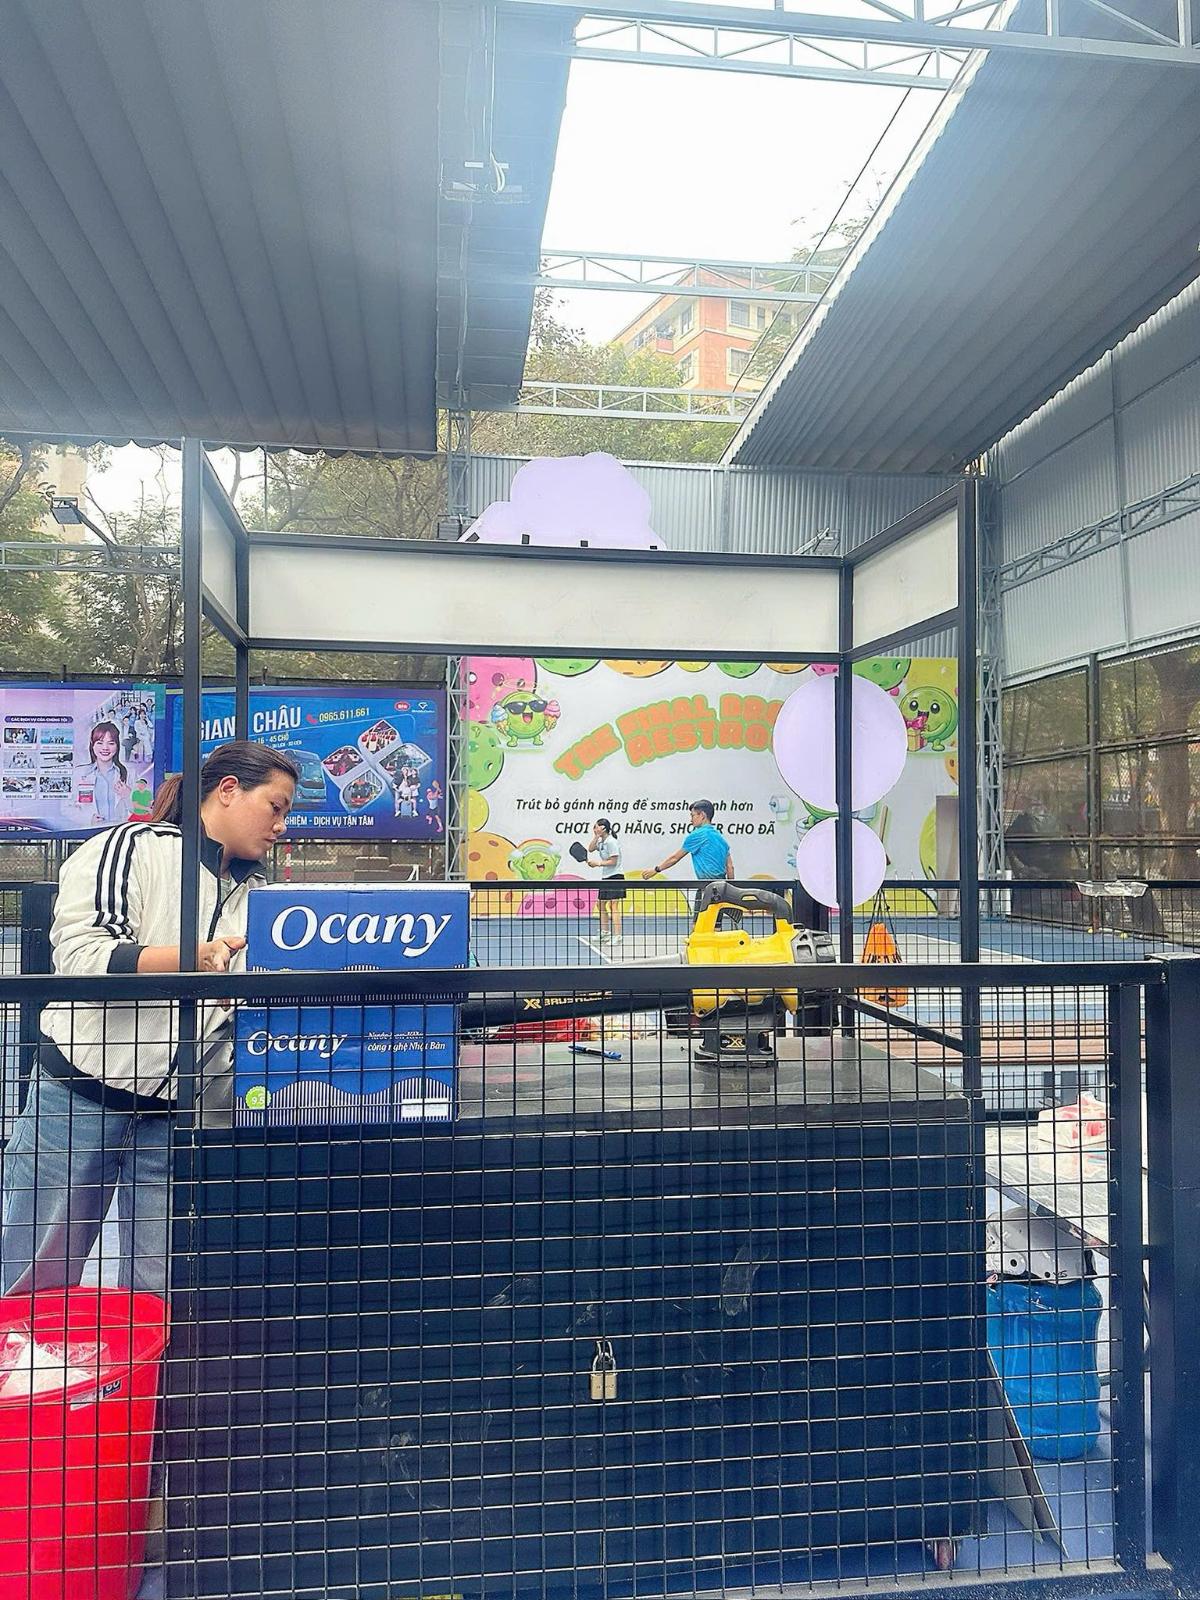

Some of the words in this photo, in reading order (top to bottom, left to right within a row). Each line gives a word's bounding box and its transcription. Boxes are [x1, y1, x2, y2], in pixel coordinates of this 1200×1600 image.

[200, 716, 236, 741] IAN
[253, 705, 301, 733] CHÂU
[319, 707, 370, 722] 0965.611.661
[553, 723, 622, 781] THE
[616, 694, 717, 737] FINAL
[624, 719, 774, 767] RESTRO
[516, 799, 541, 810] Trút
[544, 797, 560, 810] bỏ
[563, 799, 594, 812] gánh
[598, 799, 629, 813] nặng
[632, 797, 649, 810] để
[650, 800, 690, 811] smash
[730, 800, 753, 811] hơn
[284, 816, 308, 826] GHIỆM
[313, 816, 330, 827] DỊCH
[332, 816, 342, 827] VỤ
[343, 814, 357, 827] TẬN
[358, 814, 374, 826] TÂM
[555, 822, 590, 834] CHƠI
[624, 820, 665, 835] HĂNG,
[669, 822, 724, 835] SHOR
[727, 823, 755, 835] CHO
[757, 821, 775, 835] ĐÃ
[271, 905, 452, 957] Ocany
[247, 1030, 347, 1058] Ocany
[367, 1042, 387, 1053] công
[429, 1041, 446, 1050] Bản
